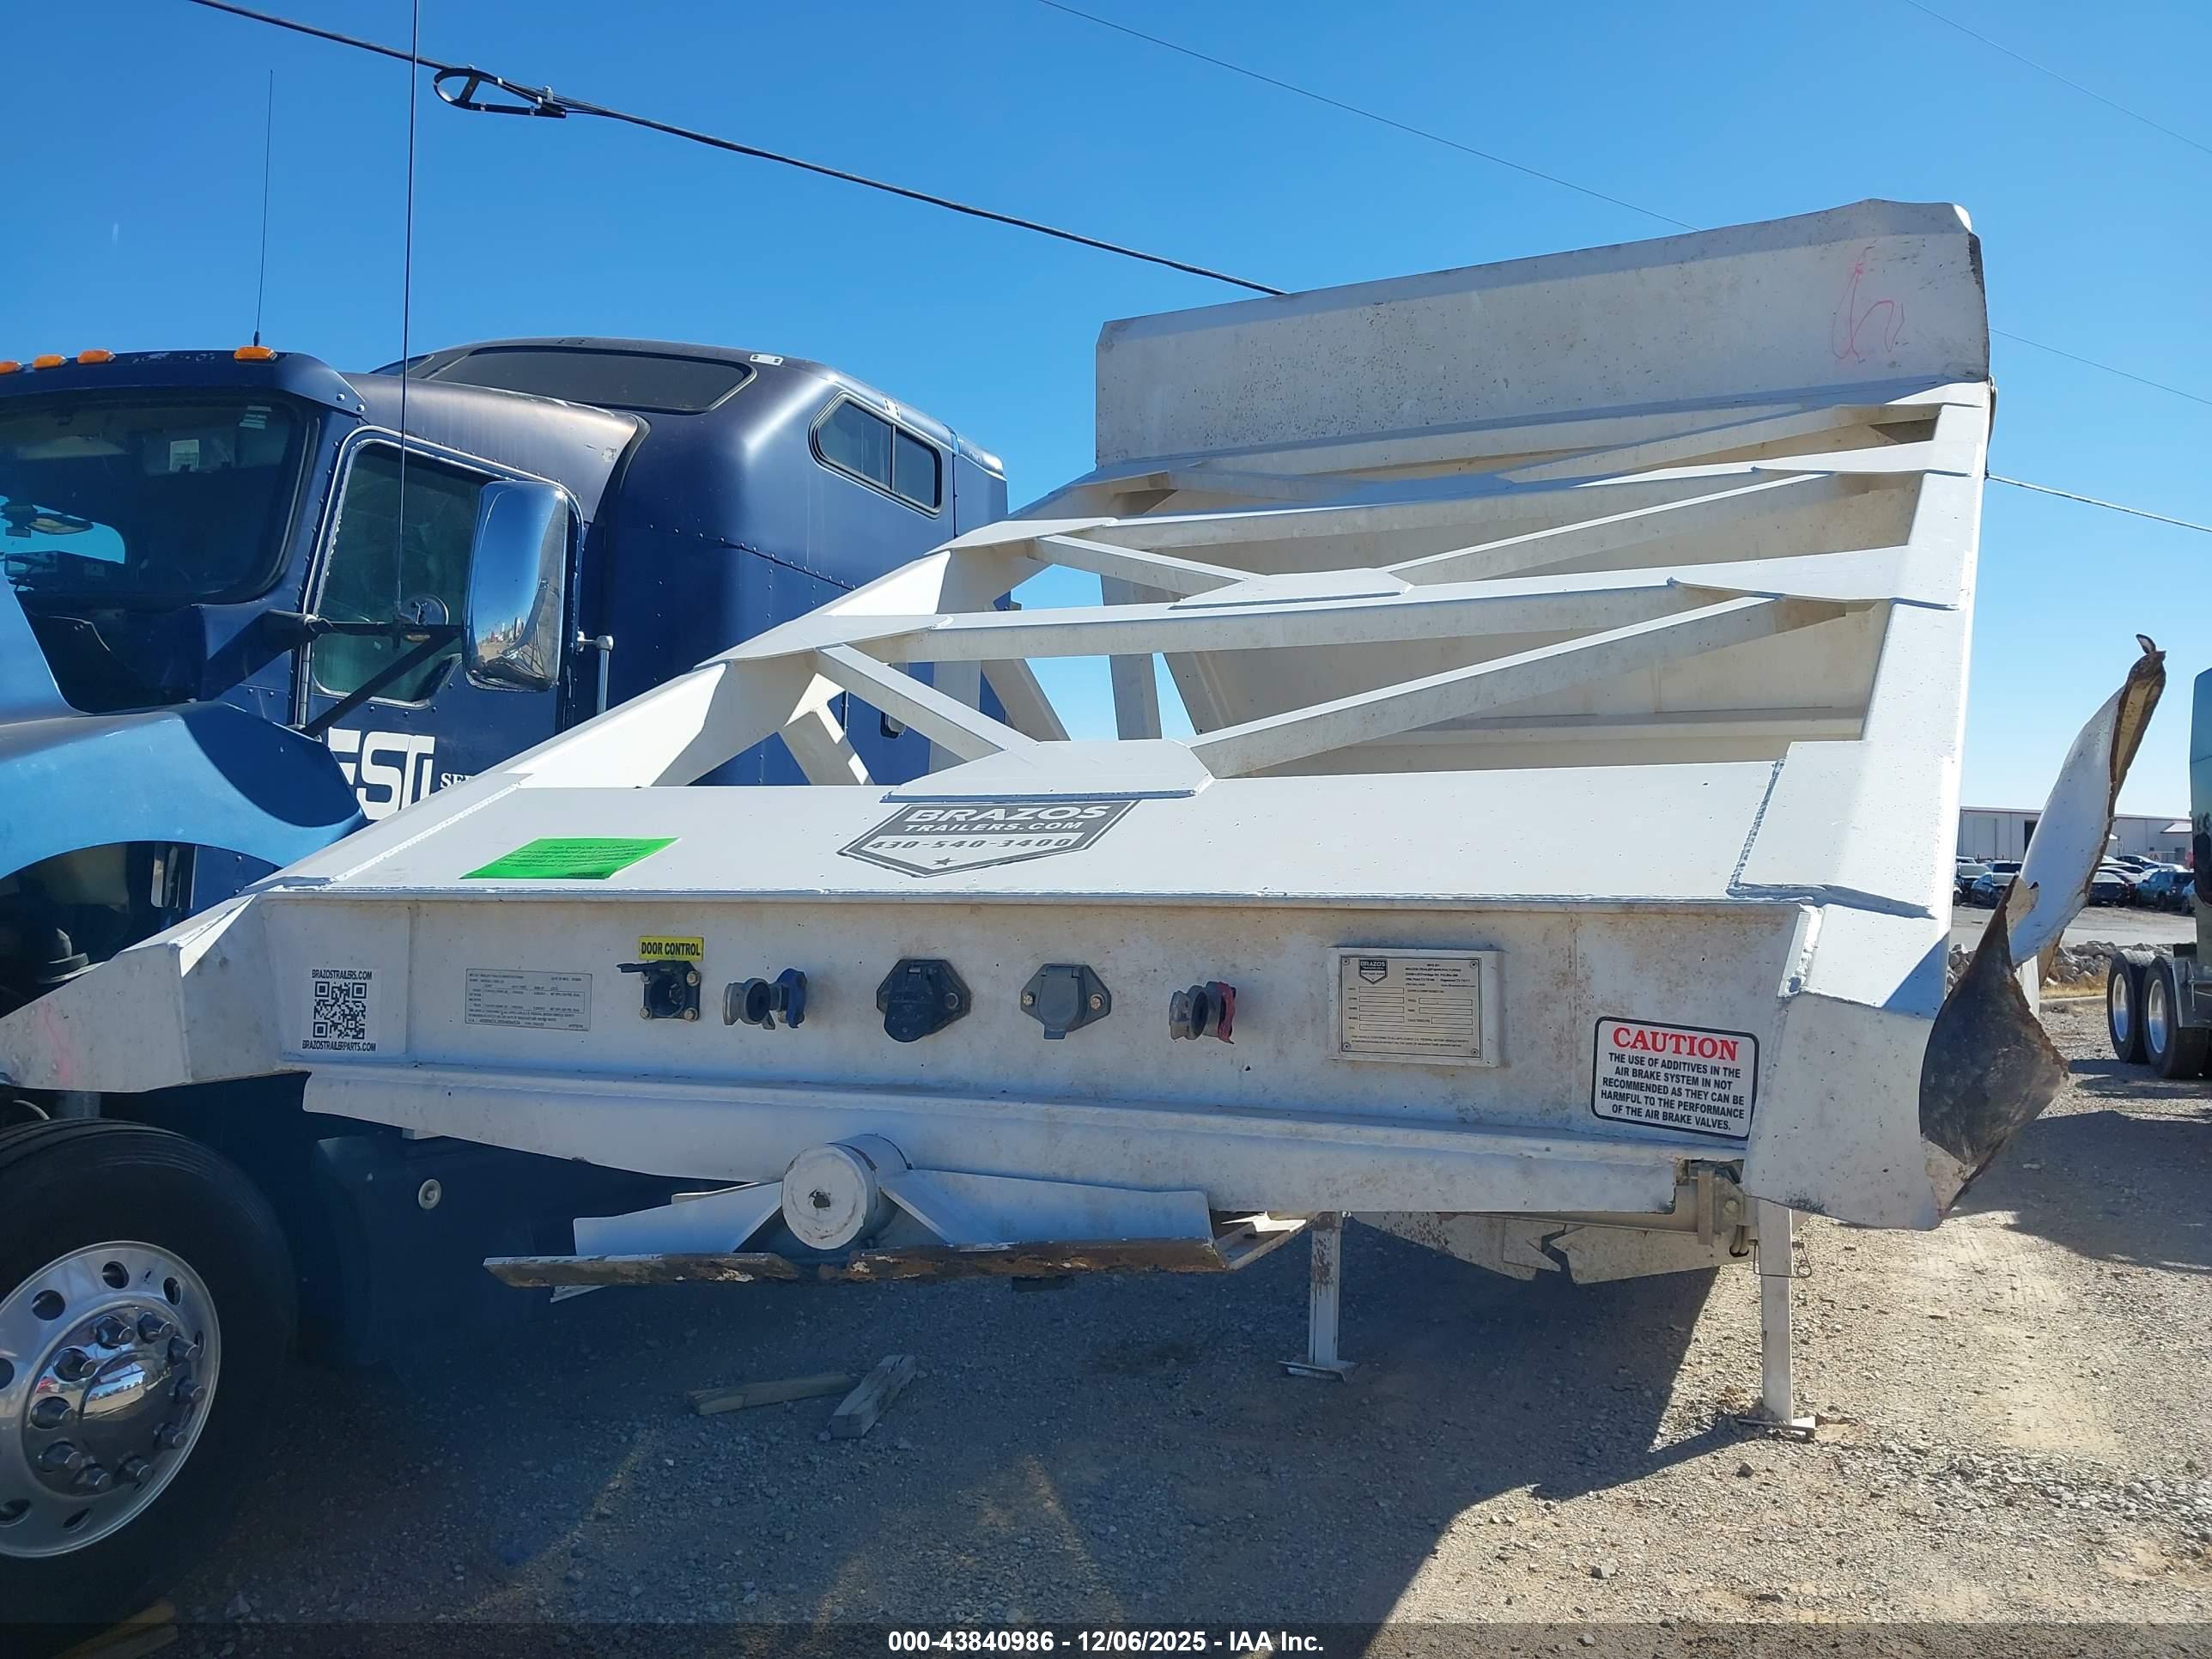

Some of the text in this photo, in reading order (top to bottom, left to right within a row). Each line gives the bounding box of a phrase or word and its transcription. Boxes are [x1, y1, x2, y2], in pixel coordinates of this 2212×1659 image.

[903, 805, 1112, 823] BRAZOS
[904, 821, 1085, 833] TRAILERS.COM
[868, 837, 1073, 850] 430-540-3400
[641, 941, 701, 957] DOOR CONTROL
[311, 969, 373, 980] BRAZOSTRAILERS.COM
[301, 1039, 376, 1052] BRAZOSTRAILERPARTS.COM
[1613, 1026, 1739, 1061] CAUTION
[1608, 1052, 1741, 1079] THE USE OF ADDITIVES IN THE
[1614, 1066, 1733, 1091] AIR BRAKE SYSTEM IN NOT
[1602, 1077, 1745, 1106] RECOMMENDED AS THEY CAN BE
[1601, 1089, 1745, 1119] HARMFUL TO THE PERFORMANCE
[1612, 1104, 1731, 1131] OF THE AIR BRAKE VALVES.
